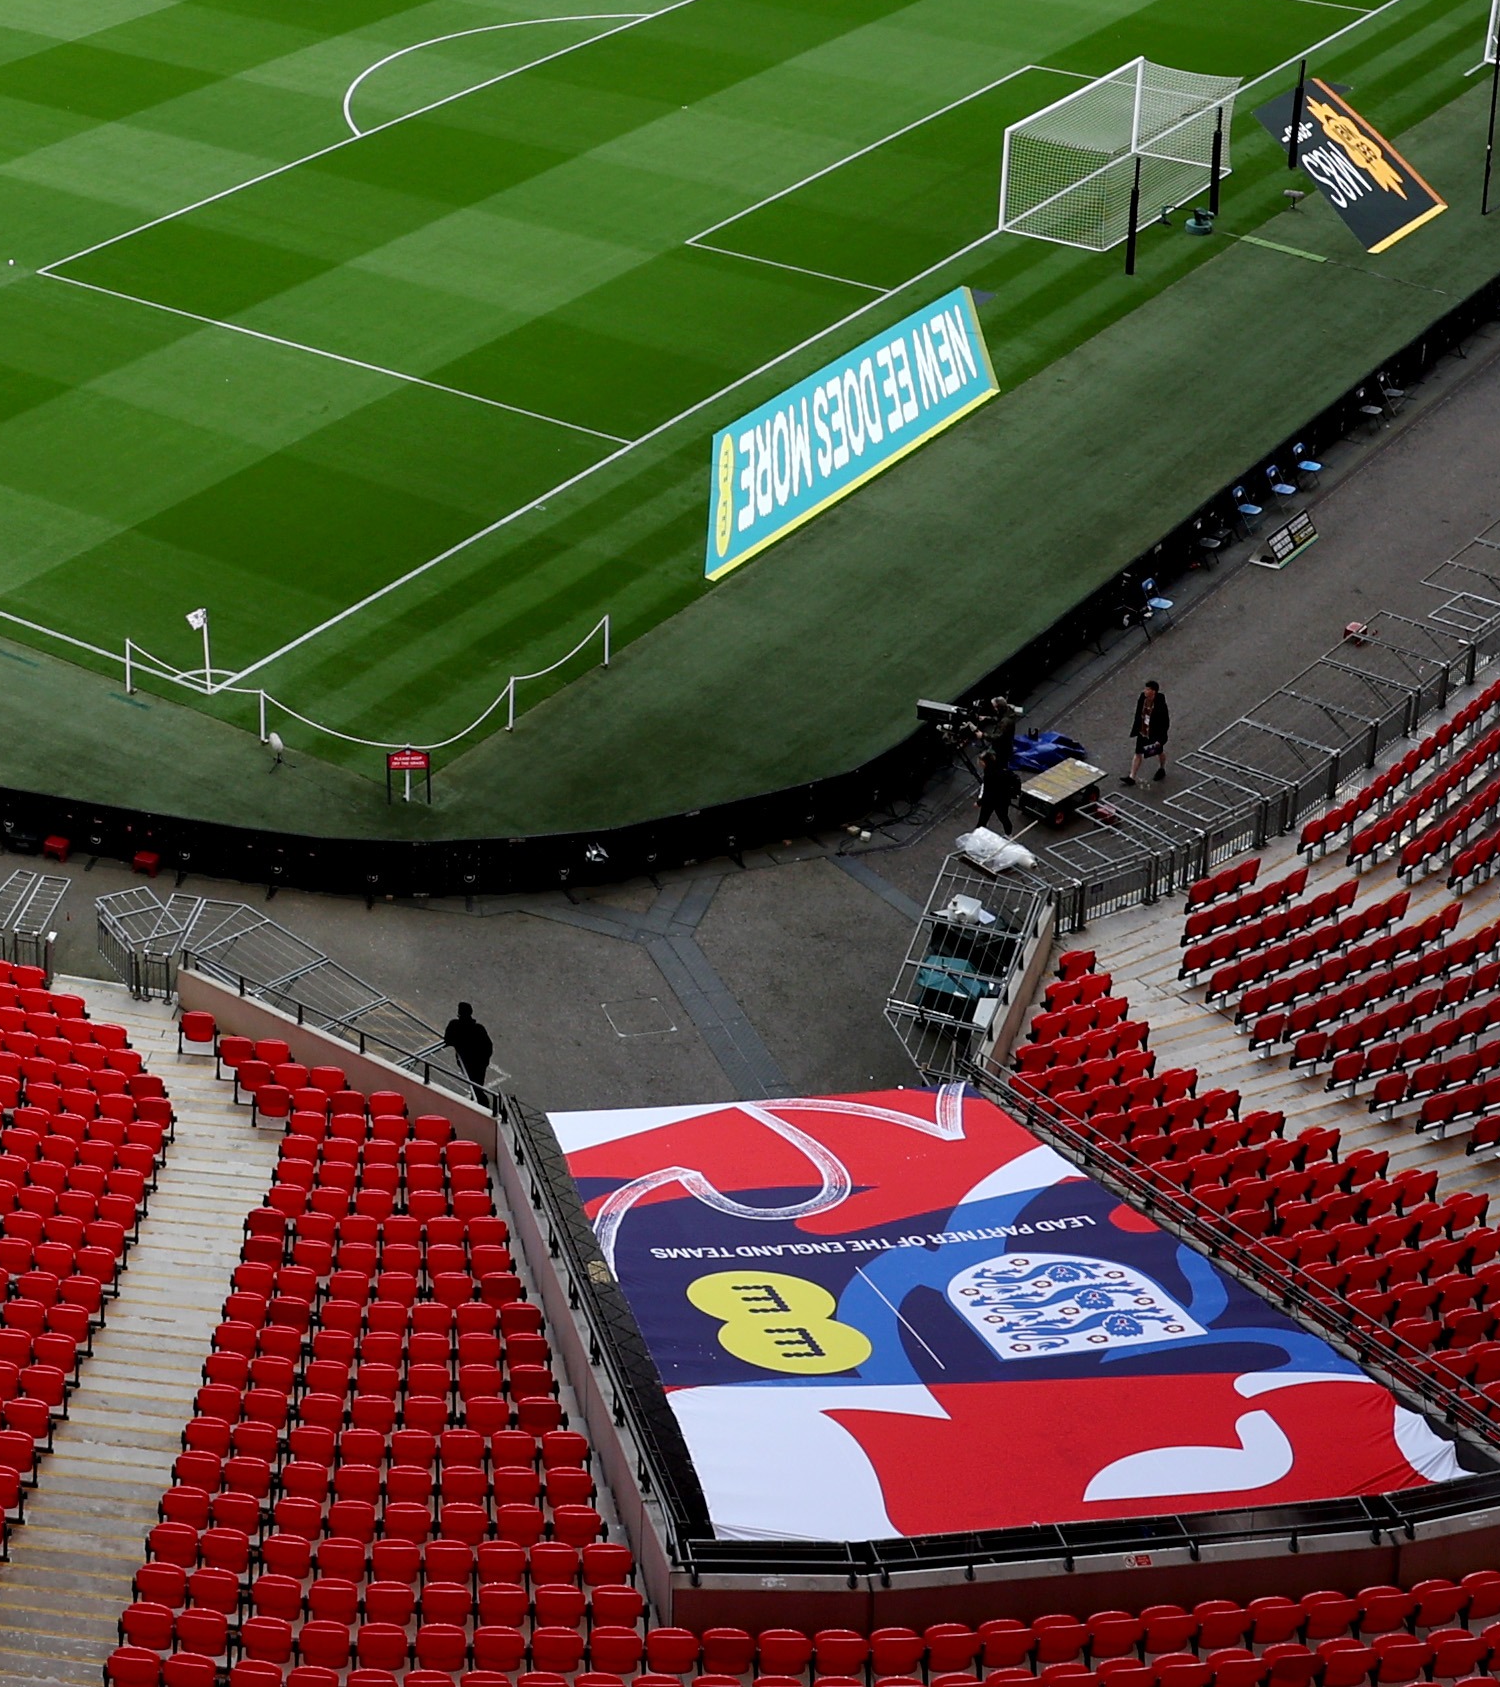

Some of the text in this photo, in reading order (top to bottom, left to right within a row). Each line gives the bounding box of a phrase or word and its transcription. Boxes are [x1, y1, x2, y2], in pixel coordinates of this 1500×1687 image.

[1302, 141, 1373, 209] M&S
[738, 304, 977, 532] NEW EE DOES MORE
[650, 1215, 1096, 1259] LEAD PARTNER OF THE ENGLAND TEAMS
